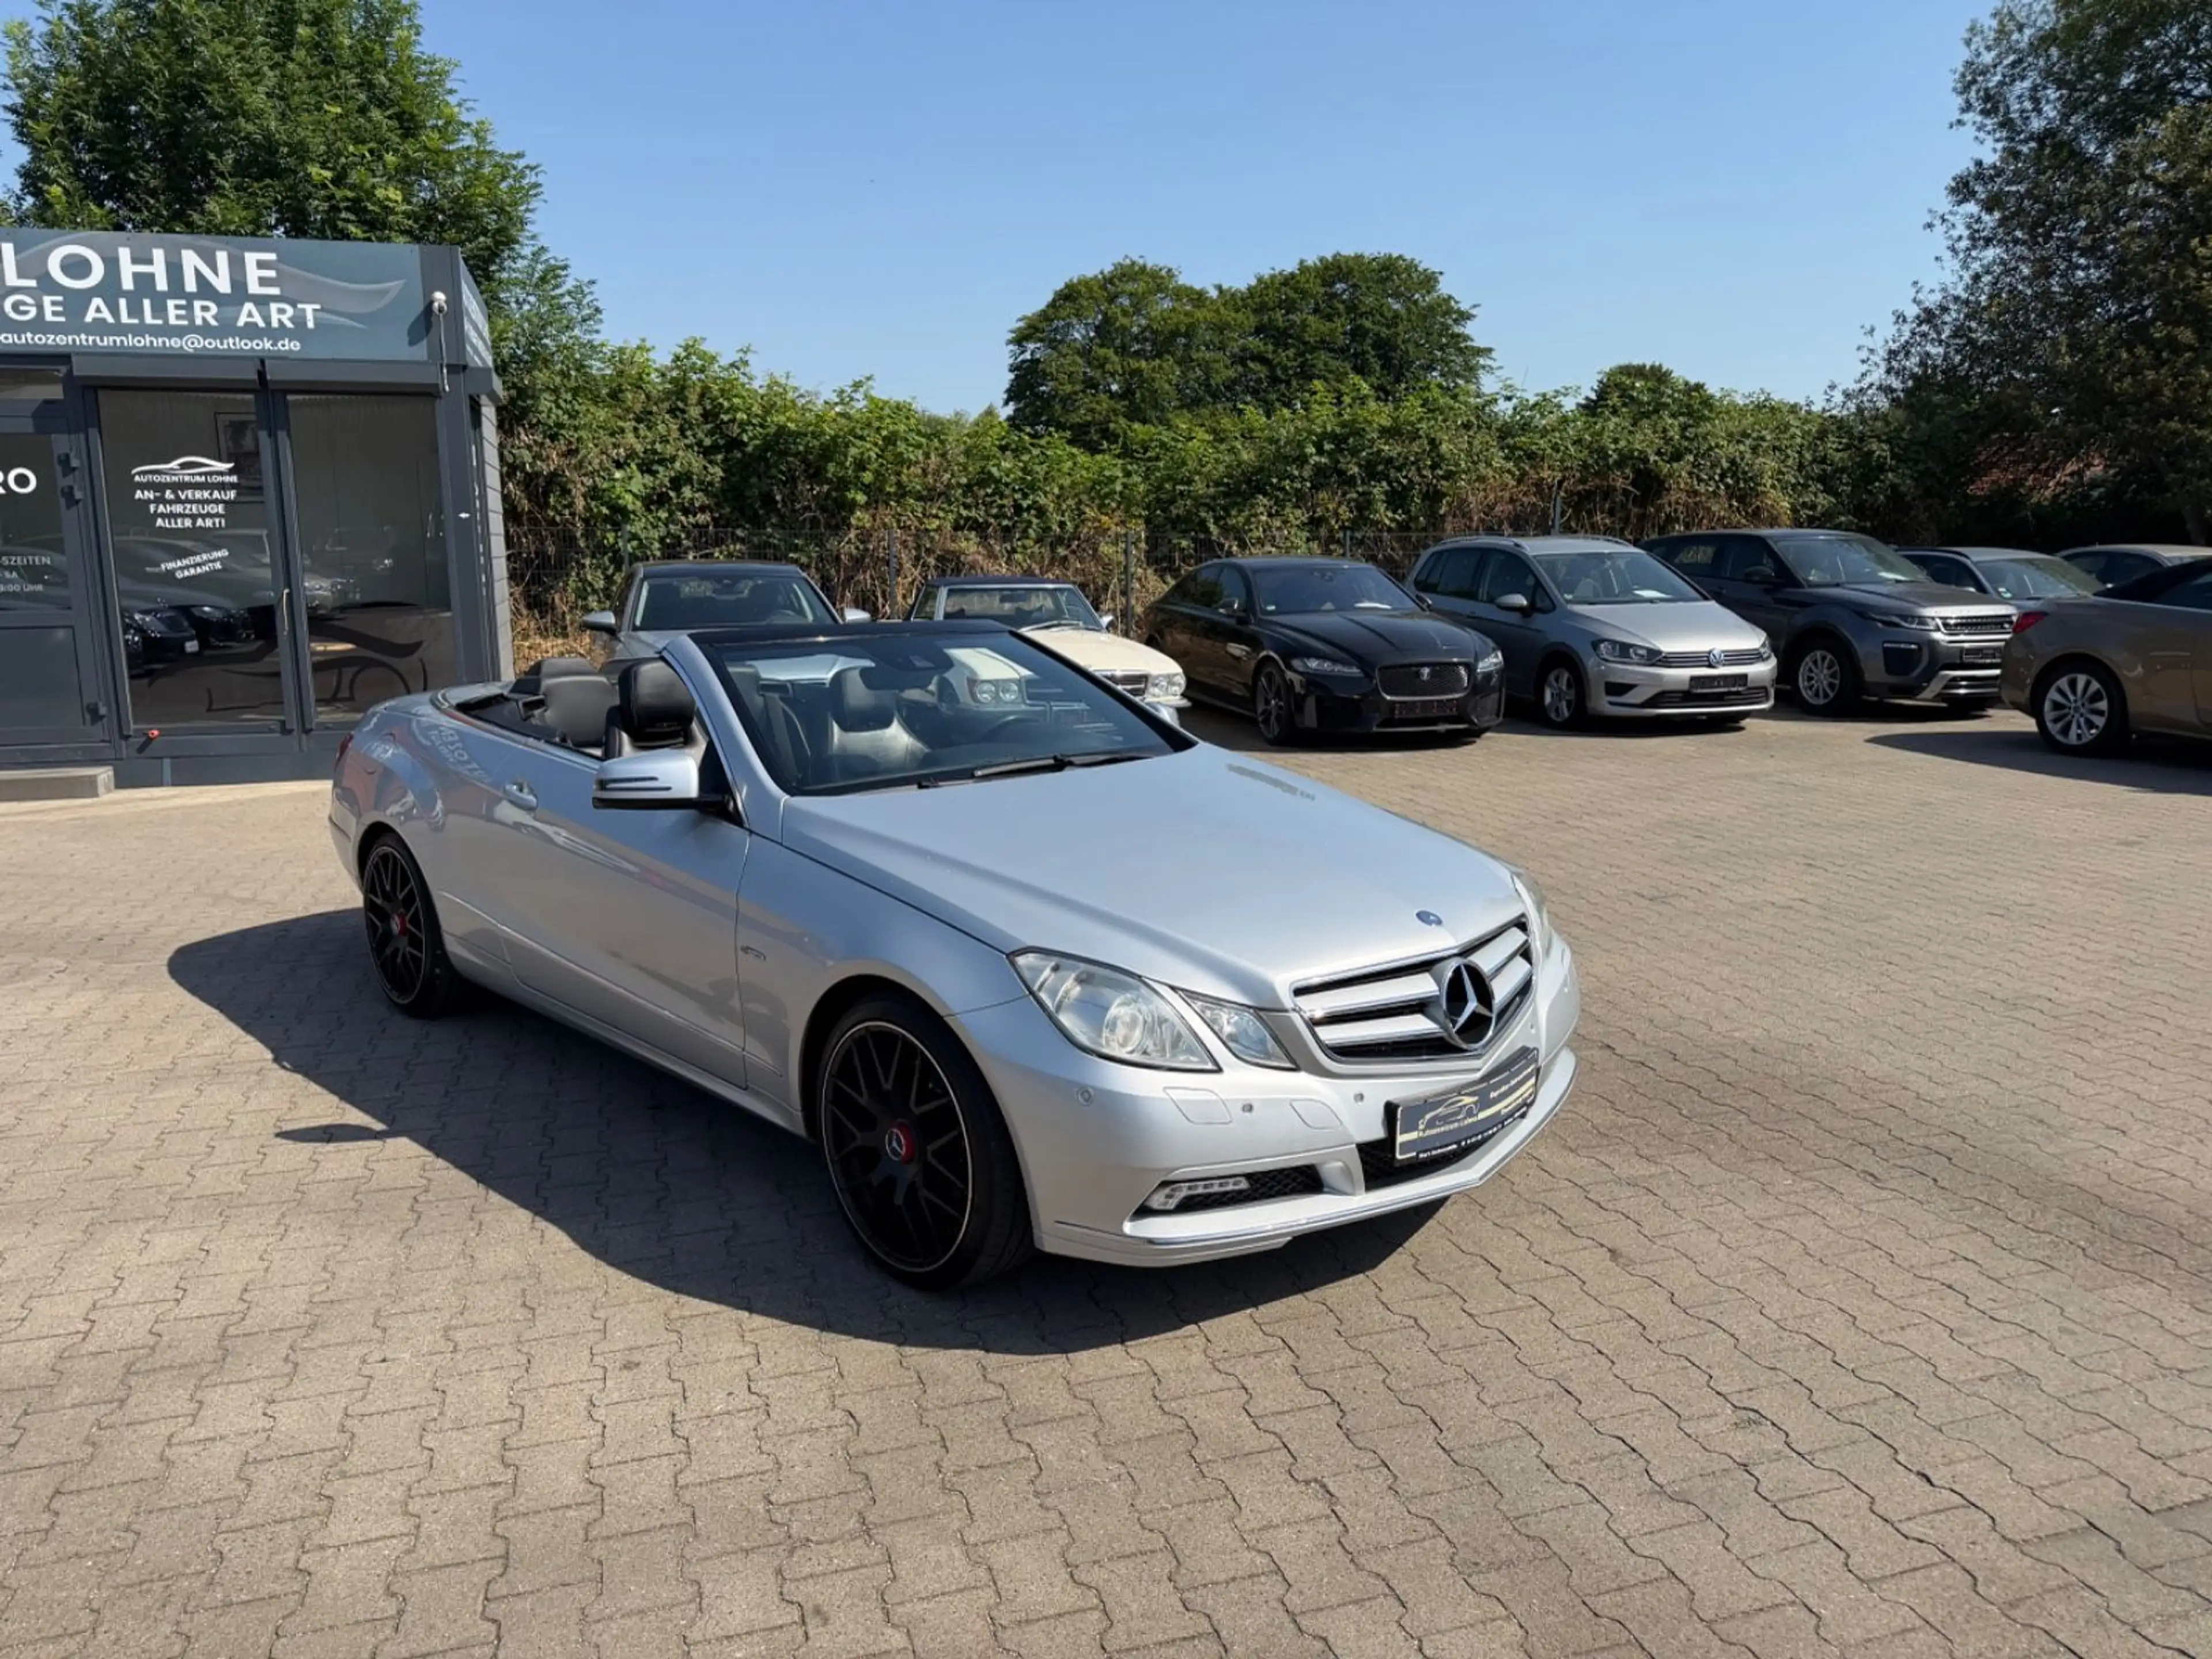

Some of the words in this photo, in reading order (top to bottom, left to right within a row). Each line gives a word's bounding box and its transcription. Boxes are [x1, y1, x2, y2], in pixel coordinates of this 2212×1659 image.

[1, 243, 281, 296] LOHNE
[3, 294, 66, 322] GE
[84, 297, 219, 327] ALLER
[236, 302, 322, 329] ART
[0, 331, 302, 353] autozentrumlohne@outlook.de
[0, 467, 37, 494] O
[134, 475, 205, 483] AUTOZENTRUM
[207, 475, 238, 483] LOHNE
[134, 489, 162, 500] AN-
[165, 489, 175, 500] &
[177, 490, 237, 501] VERKAUF
[149, 503, 225, 514] FAHRZEUGE
[156, 517, 193, 528] ALLER
